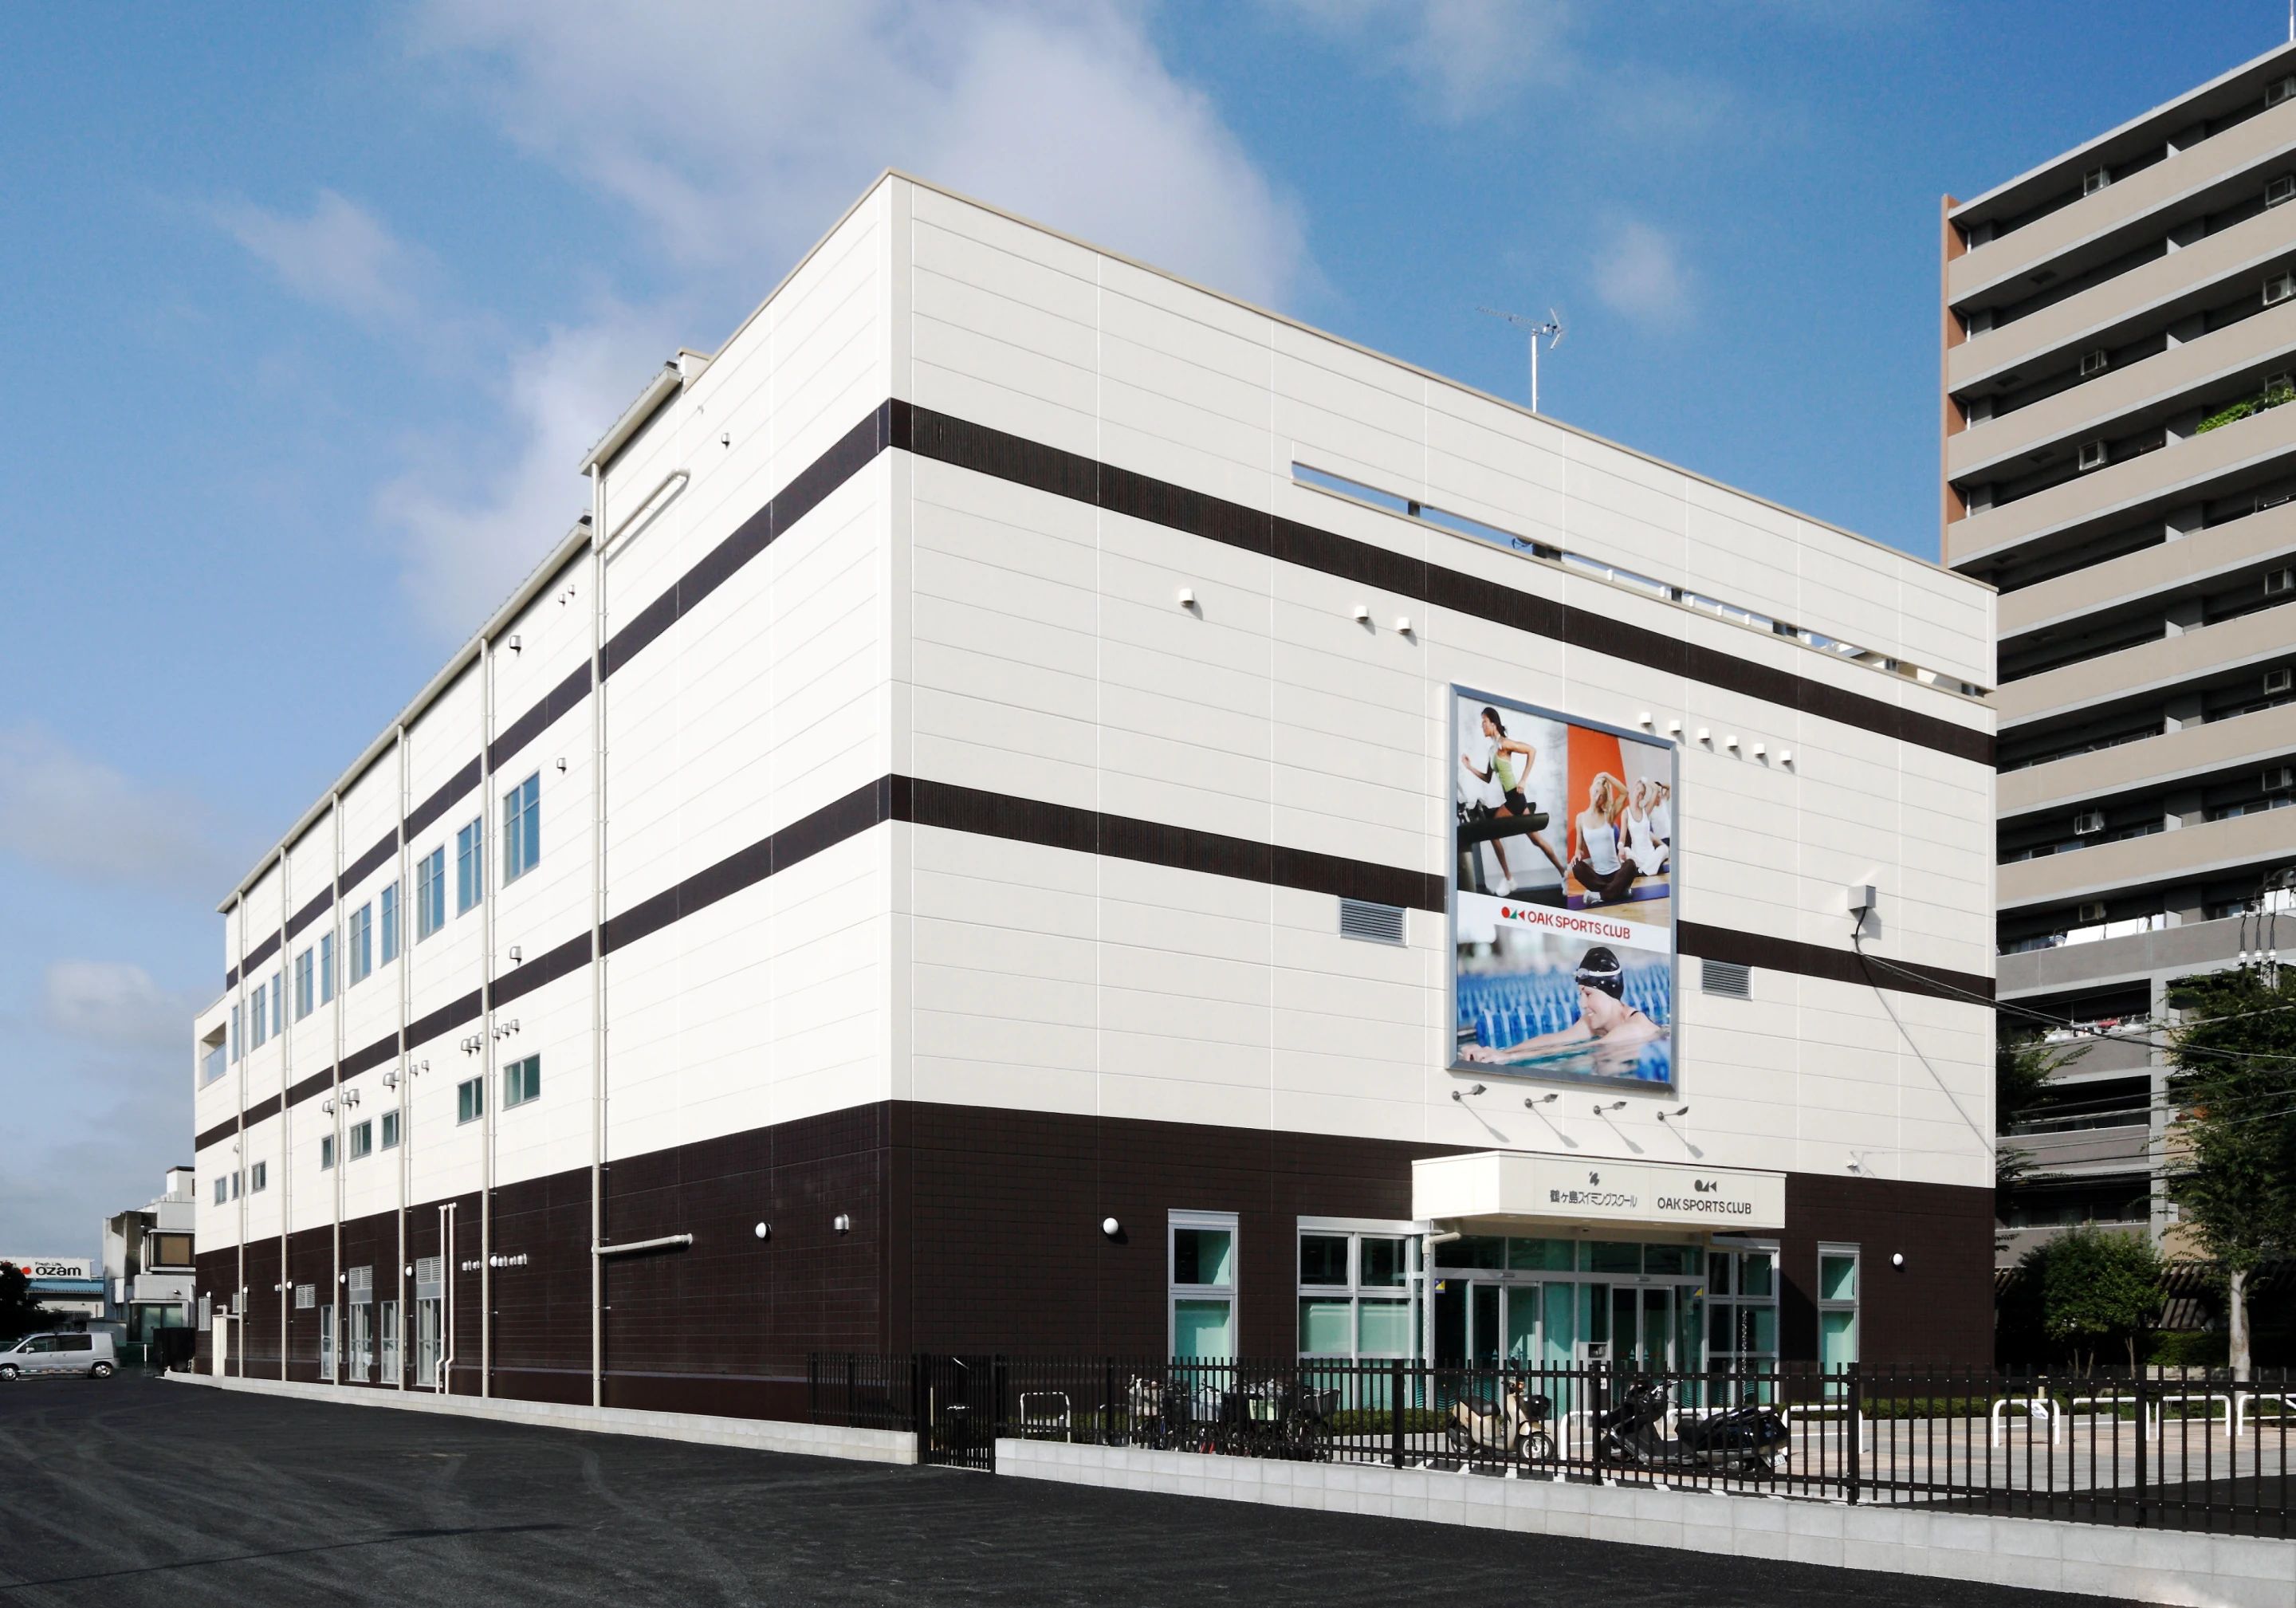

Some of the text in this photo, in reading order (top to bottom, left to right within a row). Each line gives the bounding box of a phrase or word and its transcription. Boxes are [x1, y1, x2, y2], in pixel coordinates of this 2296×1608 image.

[1527, 910, 1630, 939] OAK SPORTS CLUB
[1550, 1189, 1638, 1208] 鶴ヶ島スイミングスクール
[1657, 1197, 1751, 1215] OAK SPORTS CLUB
[35, 1266, 81, 1276] ozam
